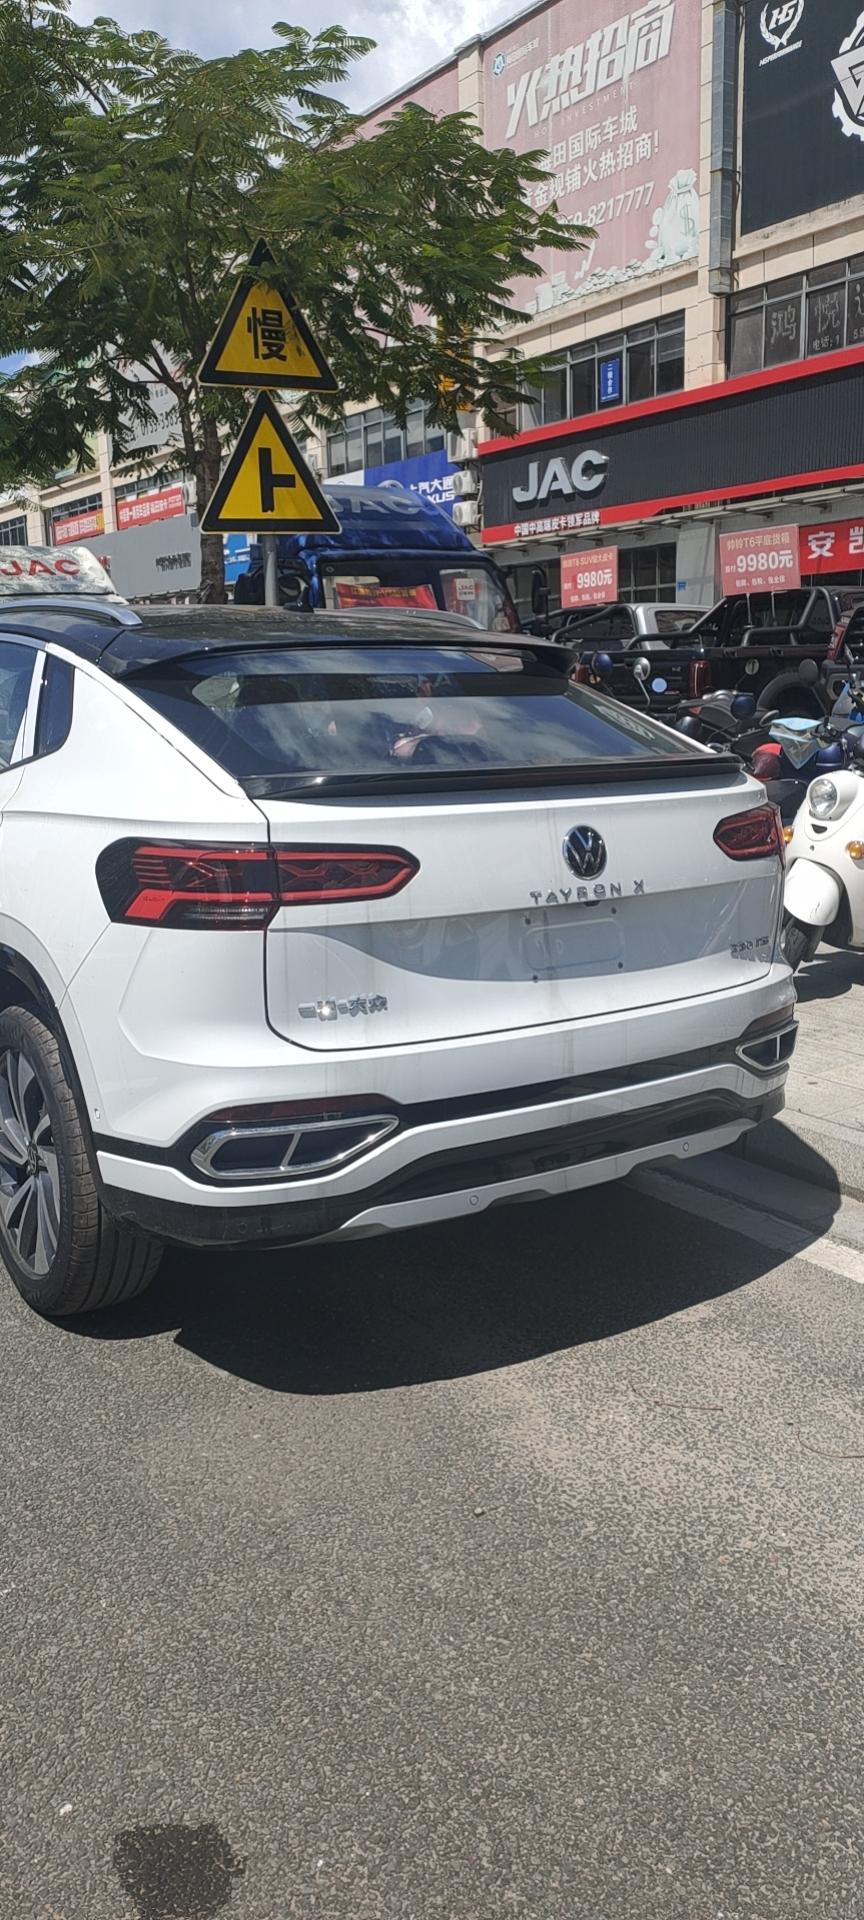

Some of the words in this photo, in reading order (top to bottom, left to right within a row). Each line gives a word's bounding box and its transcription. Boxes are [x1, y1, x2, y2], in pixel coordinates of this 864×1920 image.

[505, 0, 675, 140] 火热招商
[564, 181, 655, 226] 9-8217777
[247, 307, 287, 362] 慢
[512, 449, 609, 503] JAC
[427, 490, 456, 504] XUS
[0, 558, 80, 577] JAC
[736, 549, 793, 573] 9980元
[577, 569, 613, 589] 9980元
[530, 882, 622, 905] TAYRON
[633, 879, 645, 895] X
